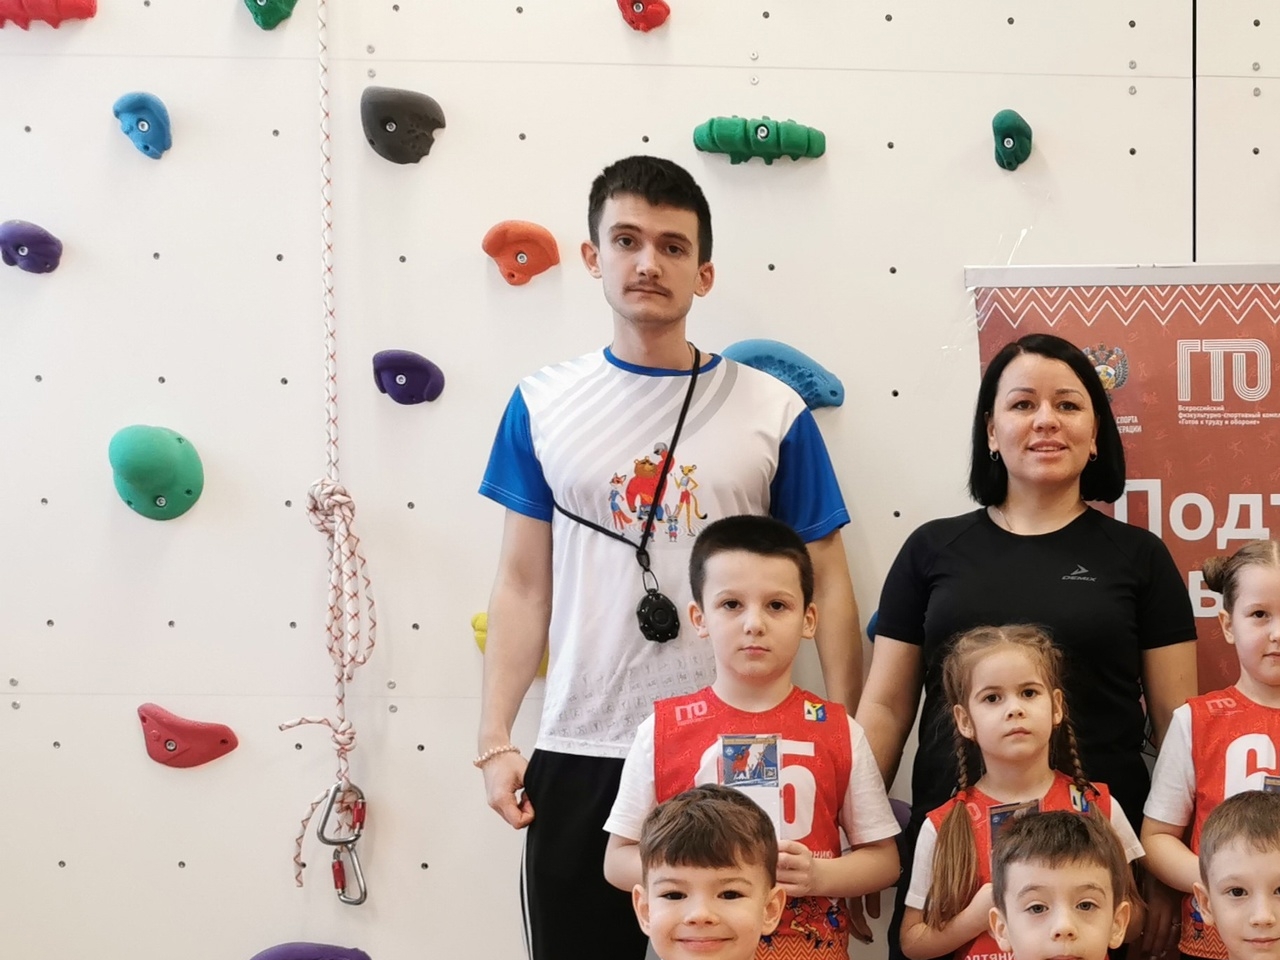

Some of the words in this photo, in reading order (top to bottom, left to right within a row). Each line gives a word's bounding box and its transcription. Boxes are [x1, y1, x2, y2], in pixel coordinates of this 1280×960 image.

[1177, 338, 1272, 402] ГТО
[1178, 404, 1225, 412] Всероссийский
[675, 700, 708, 722] ГТО
